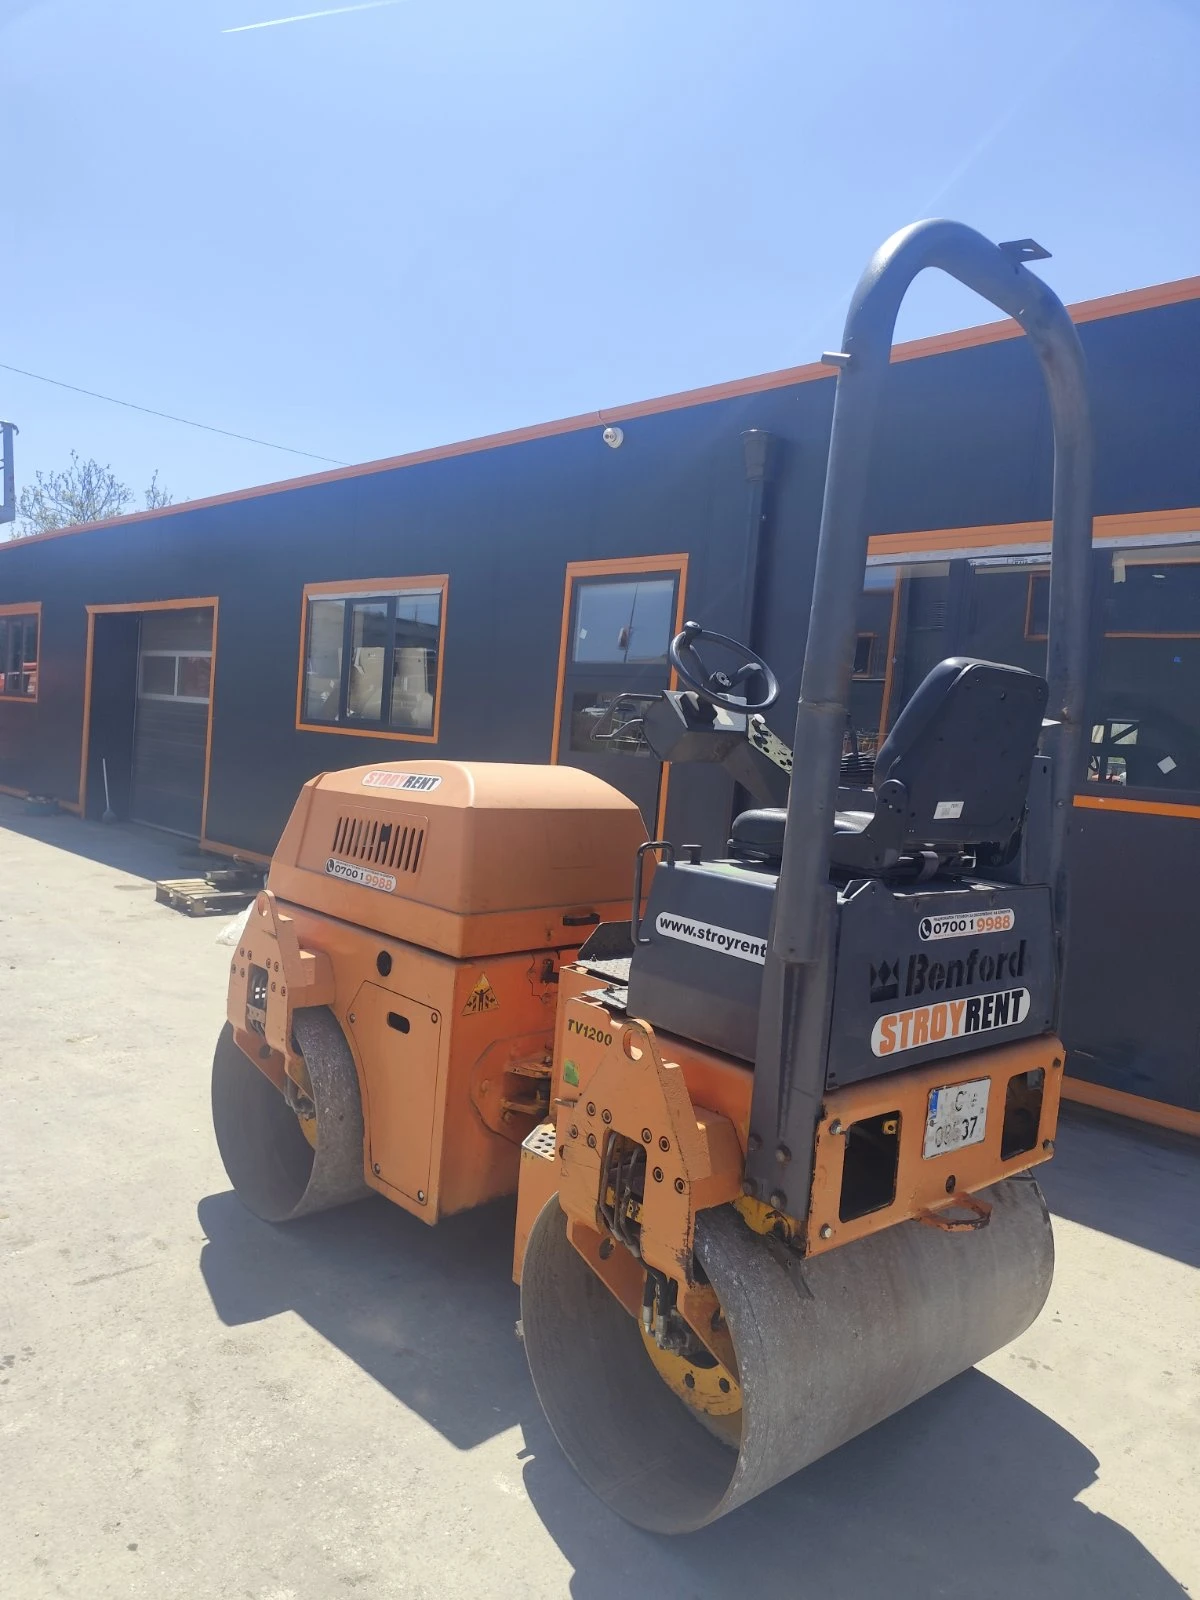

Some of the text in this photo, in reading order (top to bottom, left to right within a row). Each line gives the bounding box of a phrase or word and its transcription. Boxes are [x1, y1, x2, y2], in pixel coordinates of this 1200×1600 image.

[366, 772, 439, 790] STROYRENT
[335, 864, 358, 879] 0700
[365, 874, 393, 891] 9988
[933, 922, 967, 935] 0700
[976, 914, 1011, 932] 9988
[905, 939, 1027, 996] Benford
[567, 1018, 613, 1047] TV1200
[879, 989, 1024, 1054] STROYRENT
